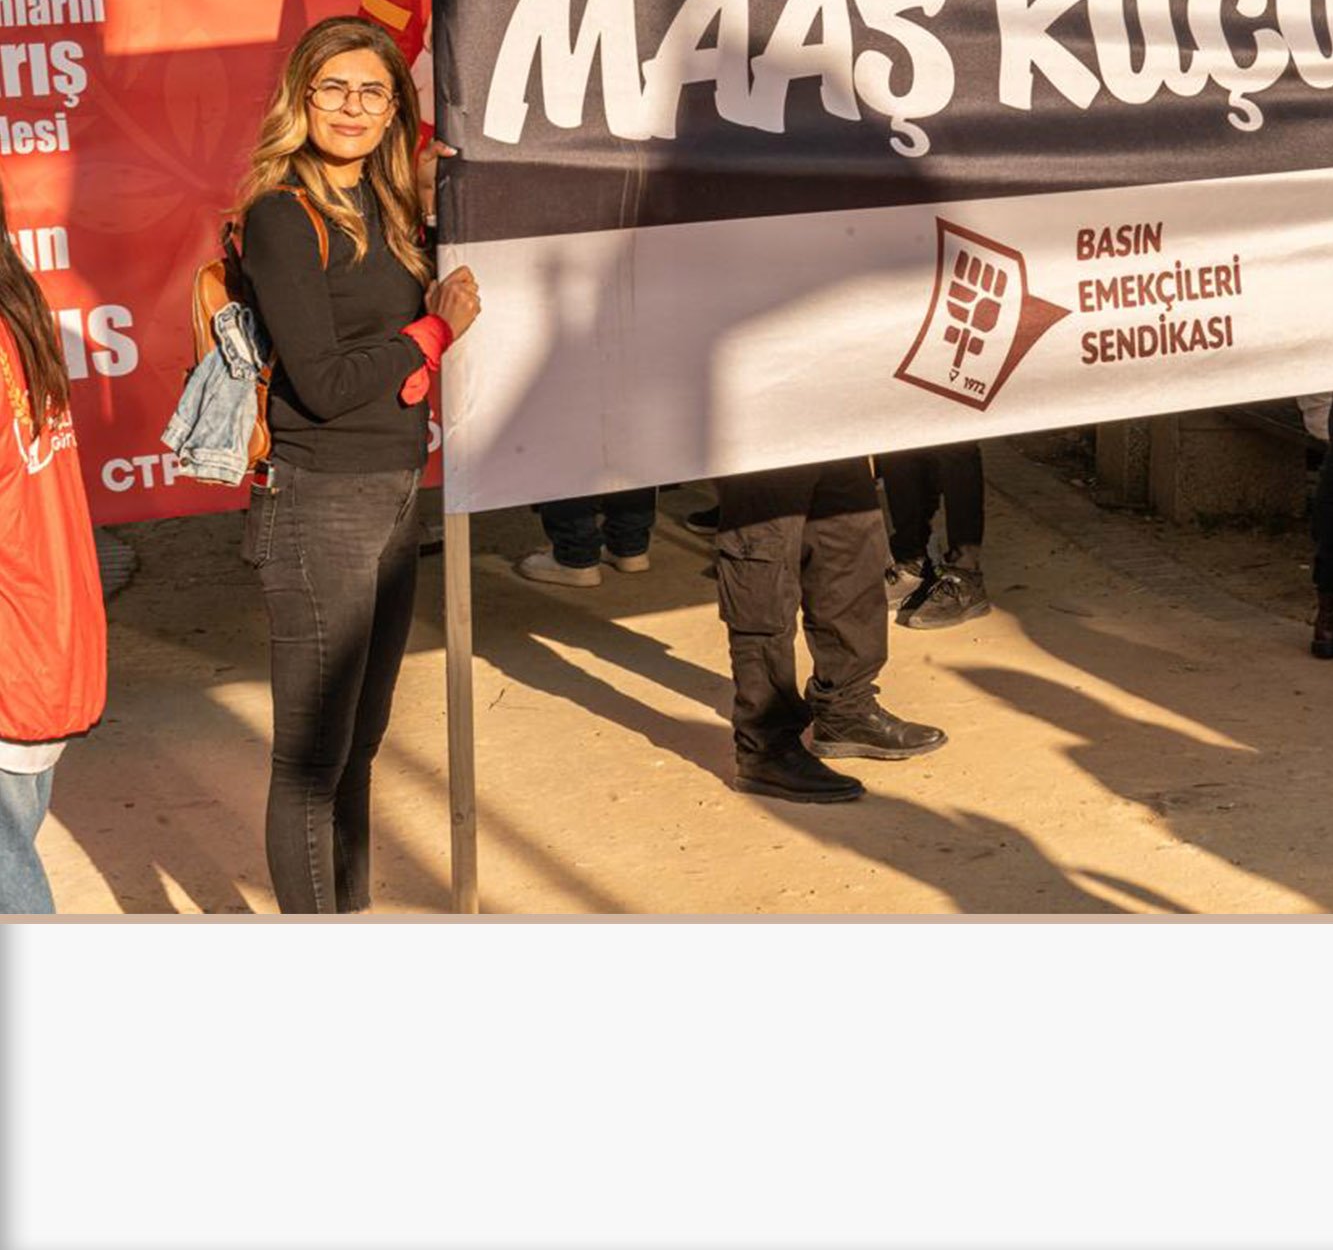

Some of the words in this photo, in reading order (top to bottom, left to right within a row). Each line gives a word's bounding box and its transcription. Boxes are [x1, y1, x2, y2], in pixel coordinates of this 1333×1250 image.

[1076, 221, 1163, 262] BASIN
[1078, 254, 1242, 313] EMEKÇİLERİ
[1081, 313, 1233, 365] SENDİKASI
[963, 375, 987, 396] 1972
